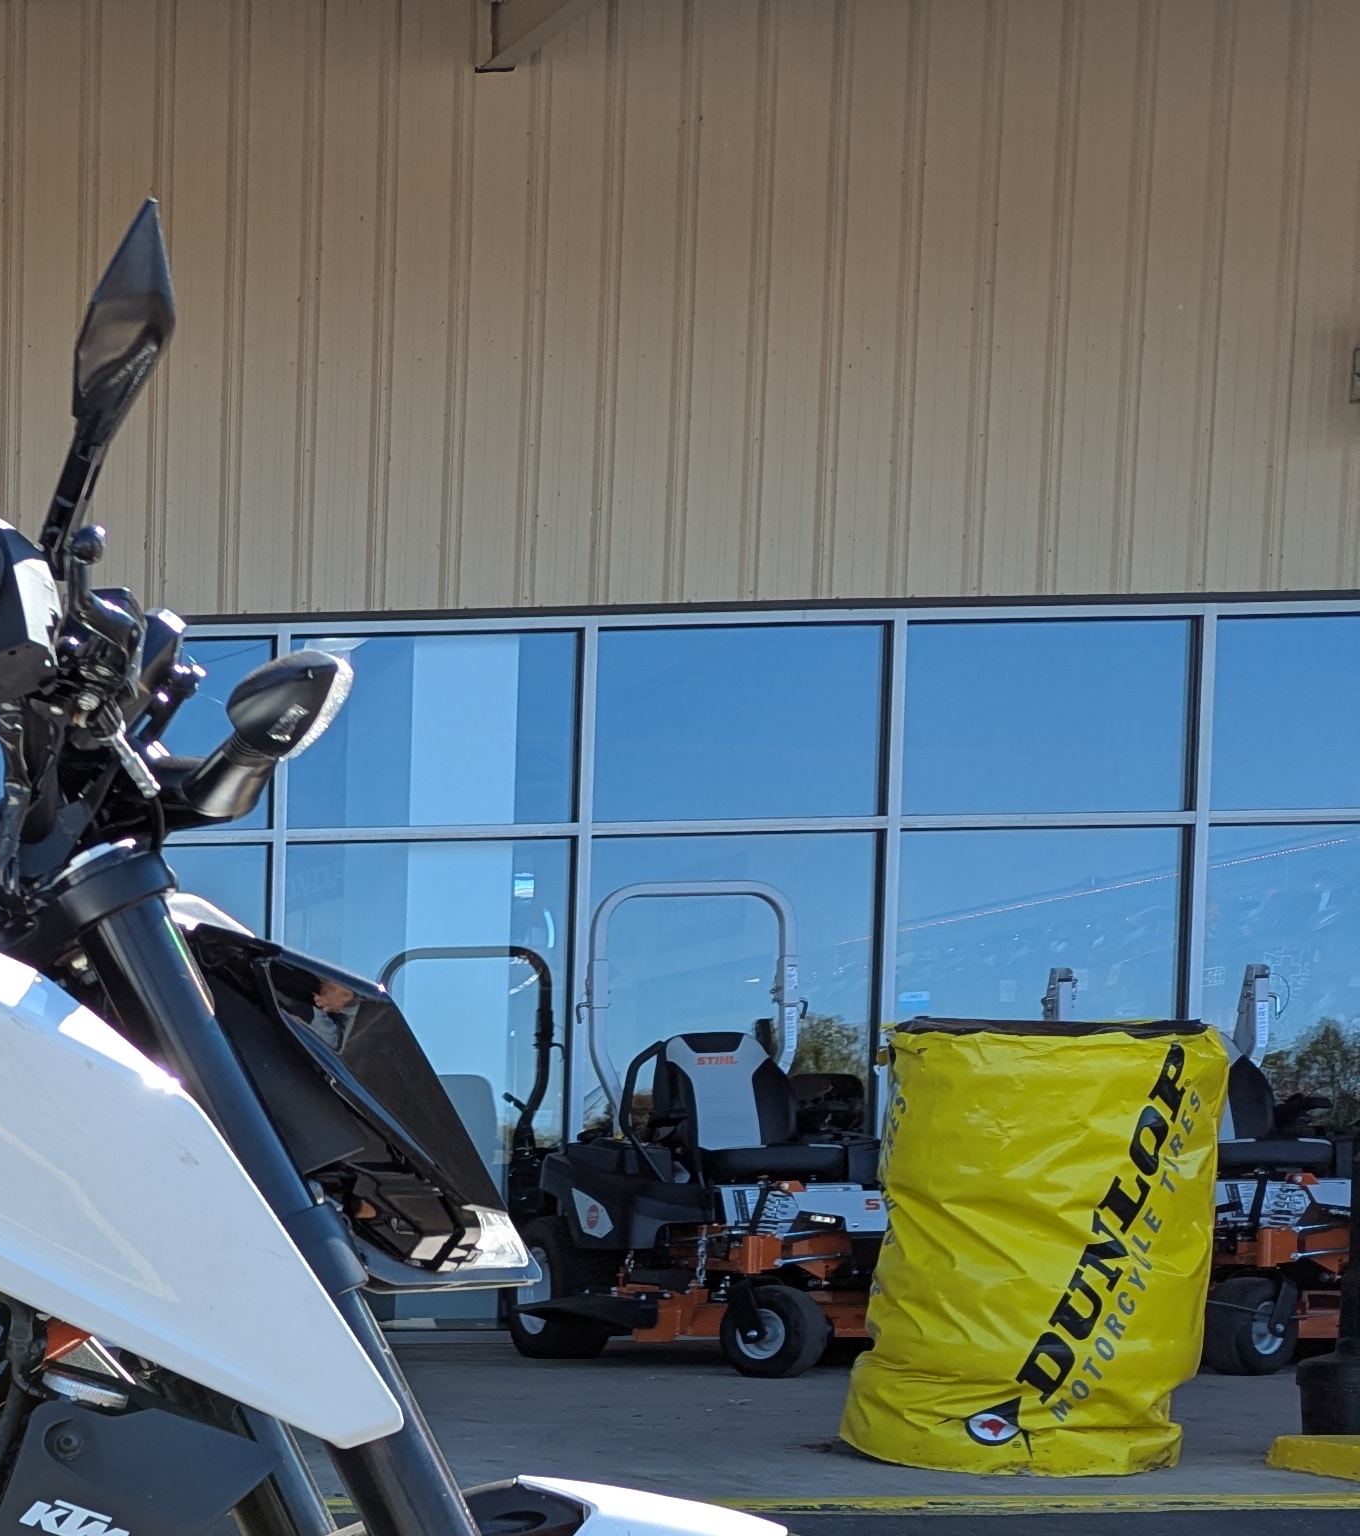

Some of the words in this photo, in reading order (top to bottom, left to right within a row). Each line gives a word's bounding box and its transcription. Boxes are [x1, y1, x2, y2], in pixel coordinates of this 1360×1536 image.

[696, 1054, 740, 1066] STIHL
[1160, 1090, 1201, 1194] TIRES
[1015, 1043, 1187, 1405] DUNLOP
